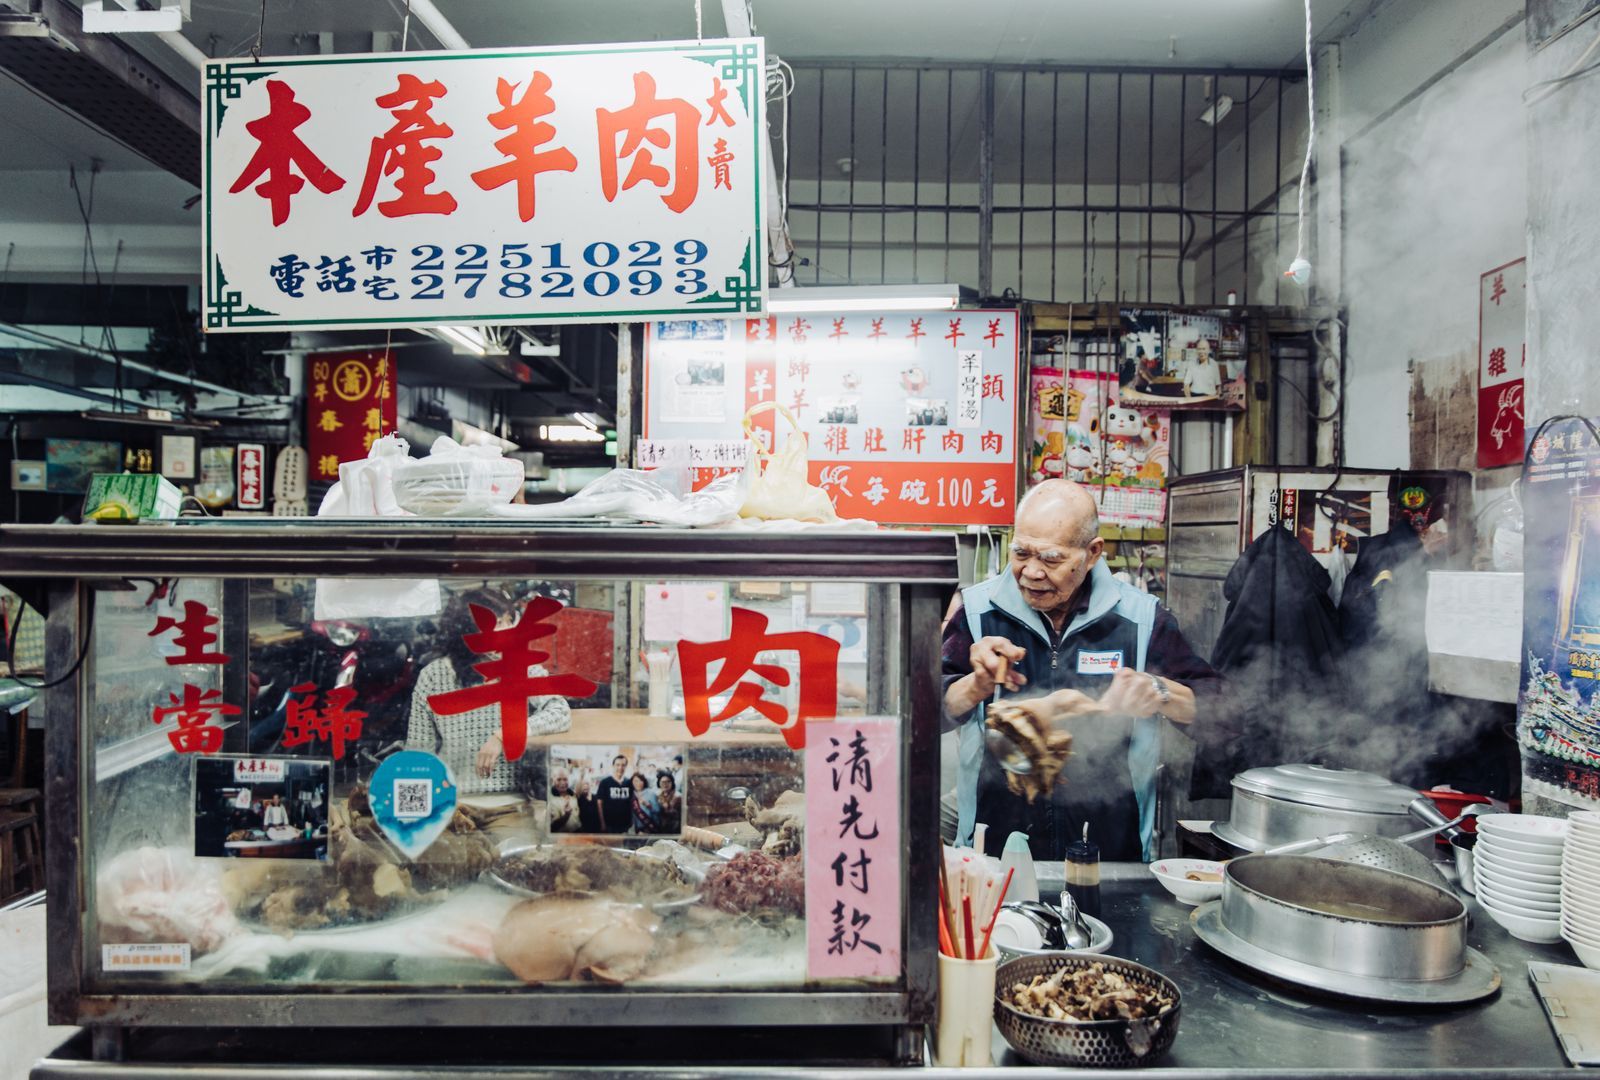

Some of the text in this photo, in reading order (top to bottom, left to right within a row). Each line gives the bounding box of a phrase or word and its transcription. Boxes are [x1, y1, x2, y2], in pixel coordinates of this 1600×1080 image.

[229, 70, 702, 227] 本產羊肉
[269, 253, 359, 299] 電話
[361, 240, 709, 272] 市 2251029
[362, 268, 709, 301] 宅 2782093
[960, 353, 979, 421] 羊骨湯
[866, 477, 1006, 508] 每碗100元
[147, 599, 232, 666] 生
[426, 596, 842, 763] 羊肉
[152, 680, 369, 761] 當歸
[825, 729, 882, 957] 請先付款
